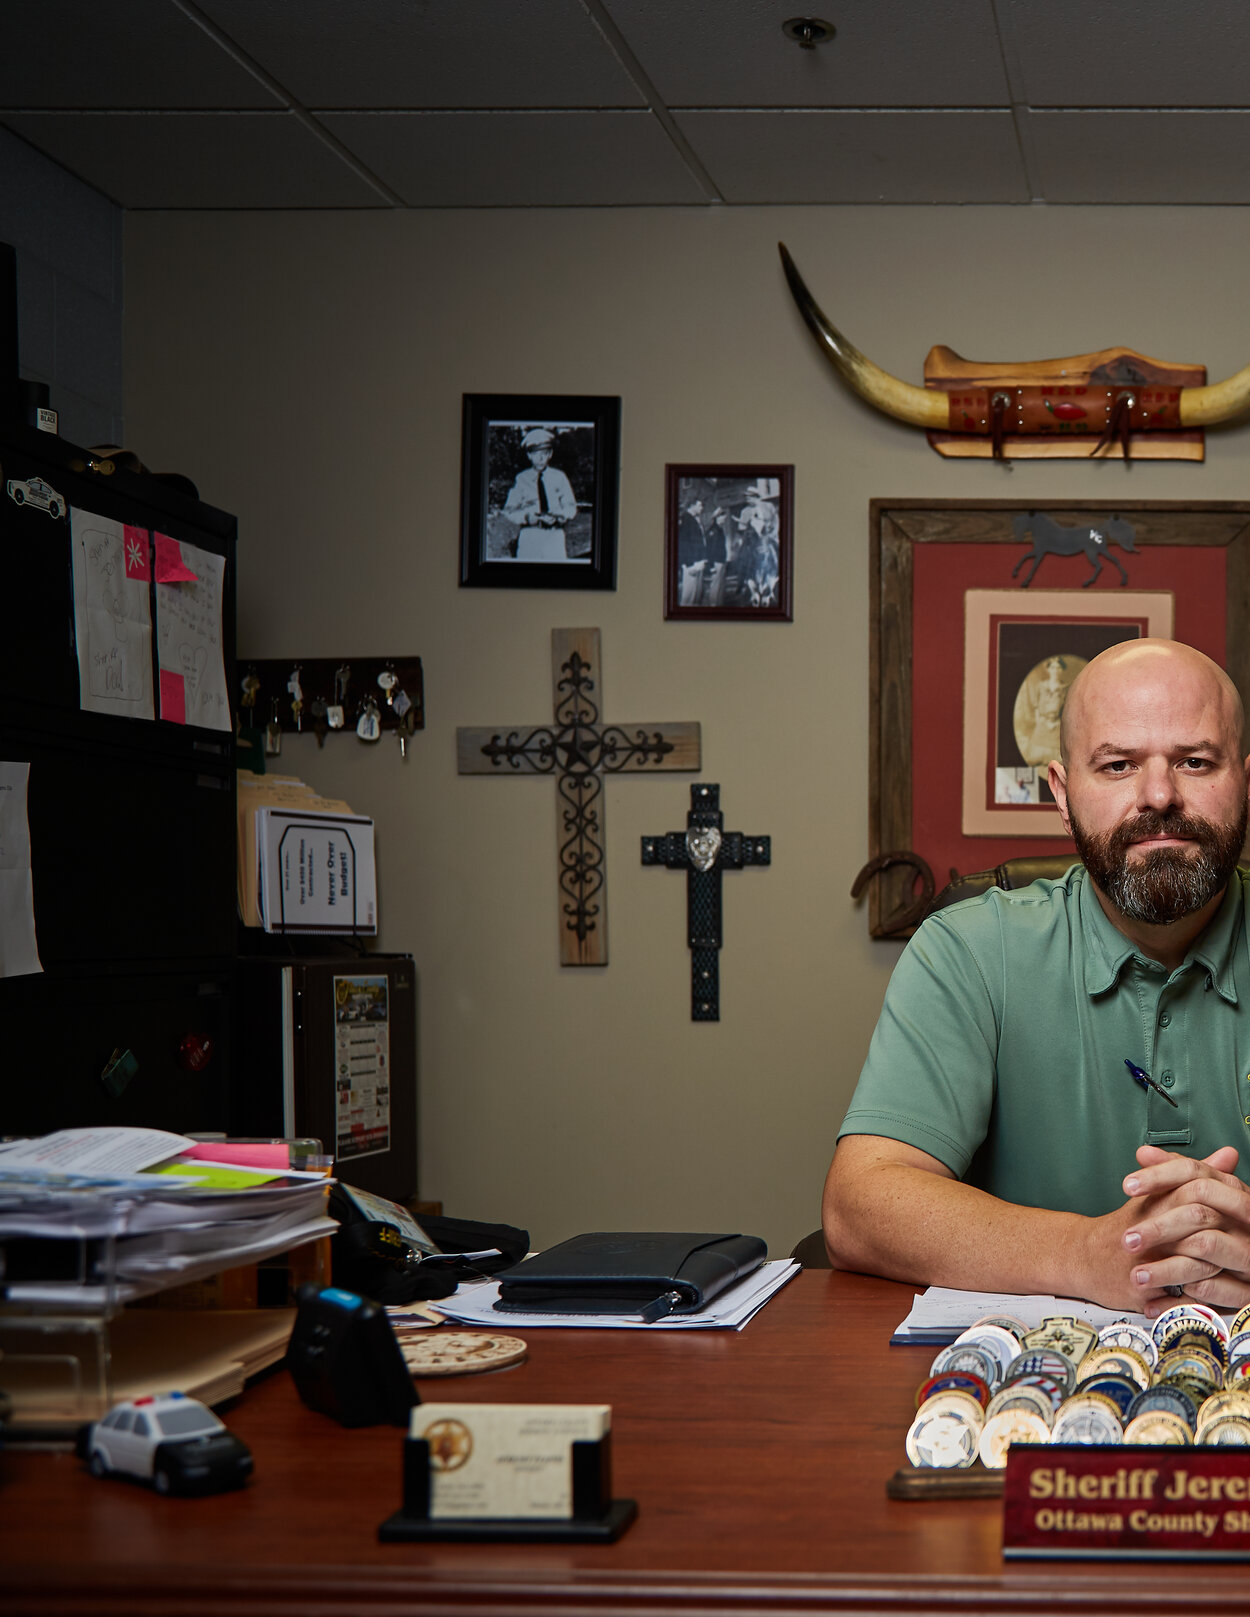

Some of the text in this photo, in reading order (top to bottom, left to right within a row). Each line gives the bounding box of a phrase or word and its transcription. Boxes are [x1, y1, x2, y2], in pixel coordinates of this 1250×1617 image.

[1171, 1318, 1214, 1332] SHERIFF
[1029, 1468, 1158, 1500] Sheriff
[1035, 1508, 1123, 1533] Ottawa
[1129, 1510, 1220, 1537] County
